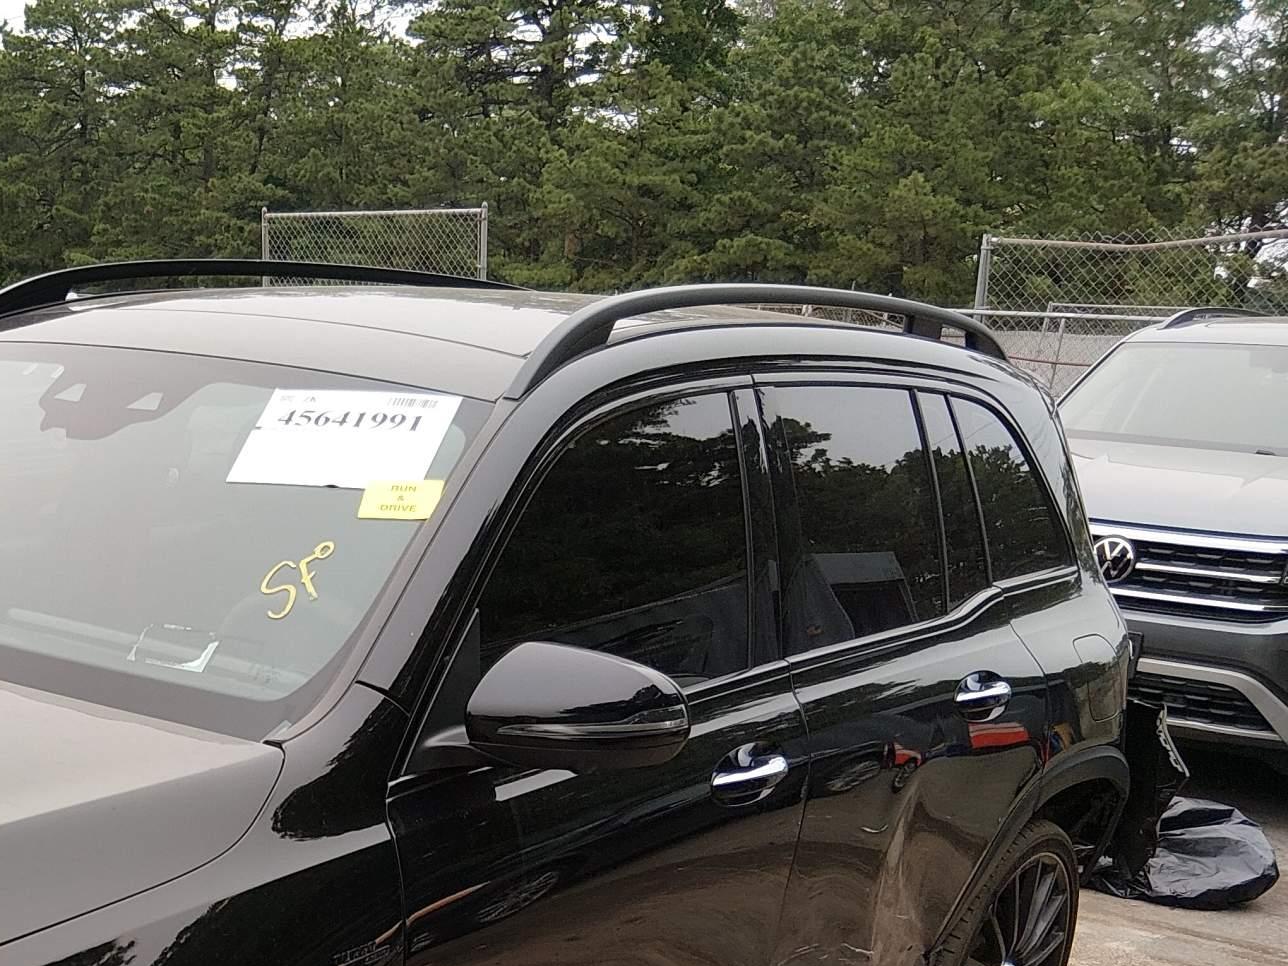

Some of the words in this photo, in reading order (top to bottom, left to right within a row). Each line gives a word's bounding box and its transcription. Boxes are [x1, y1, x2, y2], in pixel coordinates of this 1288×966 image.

[277, 408, 425, 433] 45641991
[390, 484, 418, 493] RUN
[379, 503, 417, 513] DRIVE
